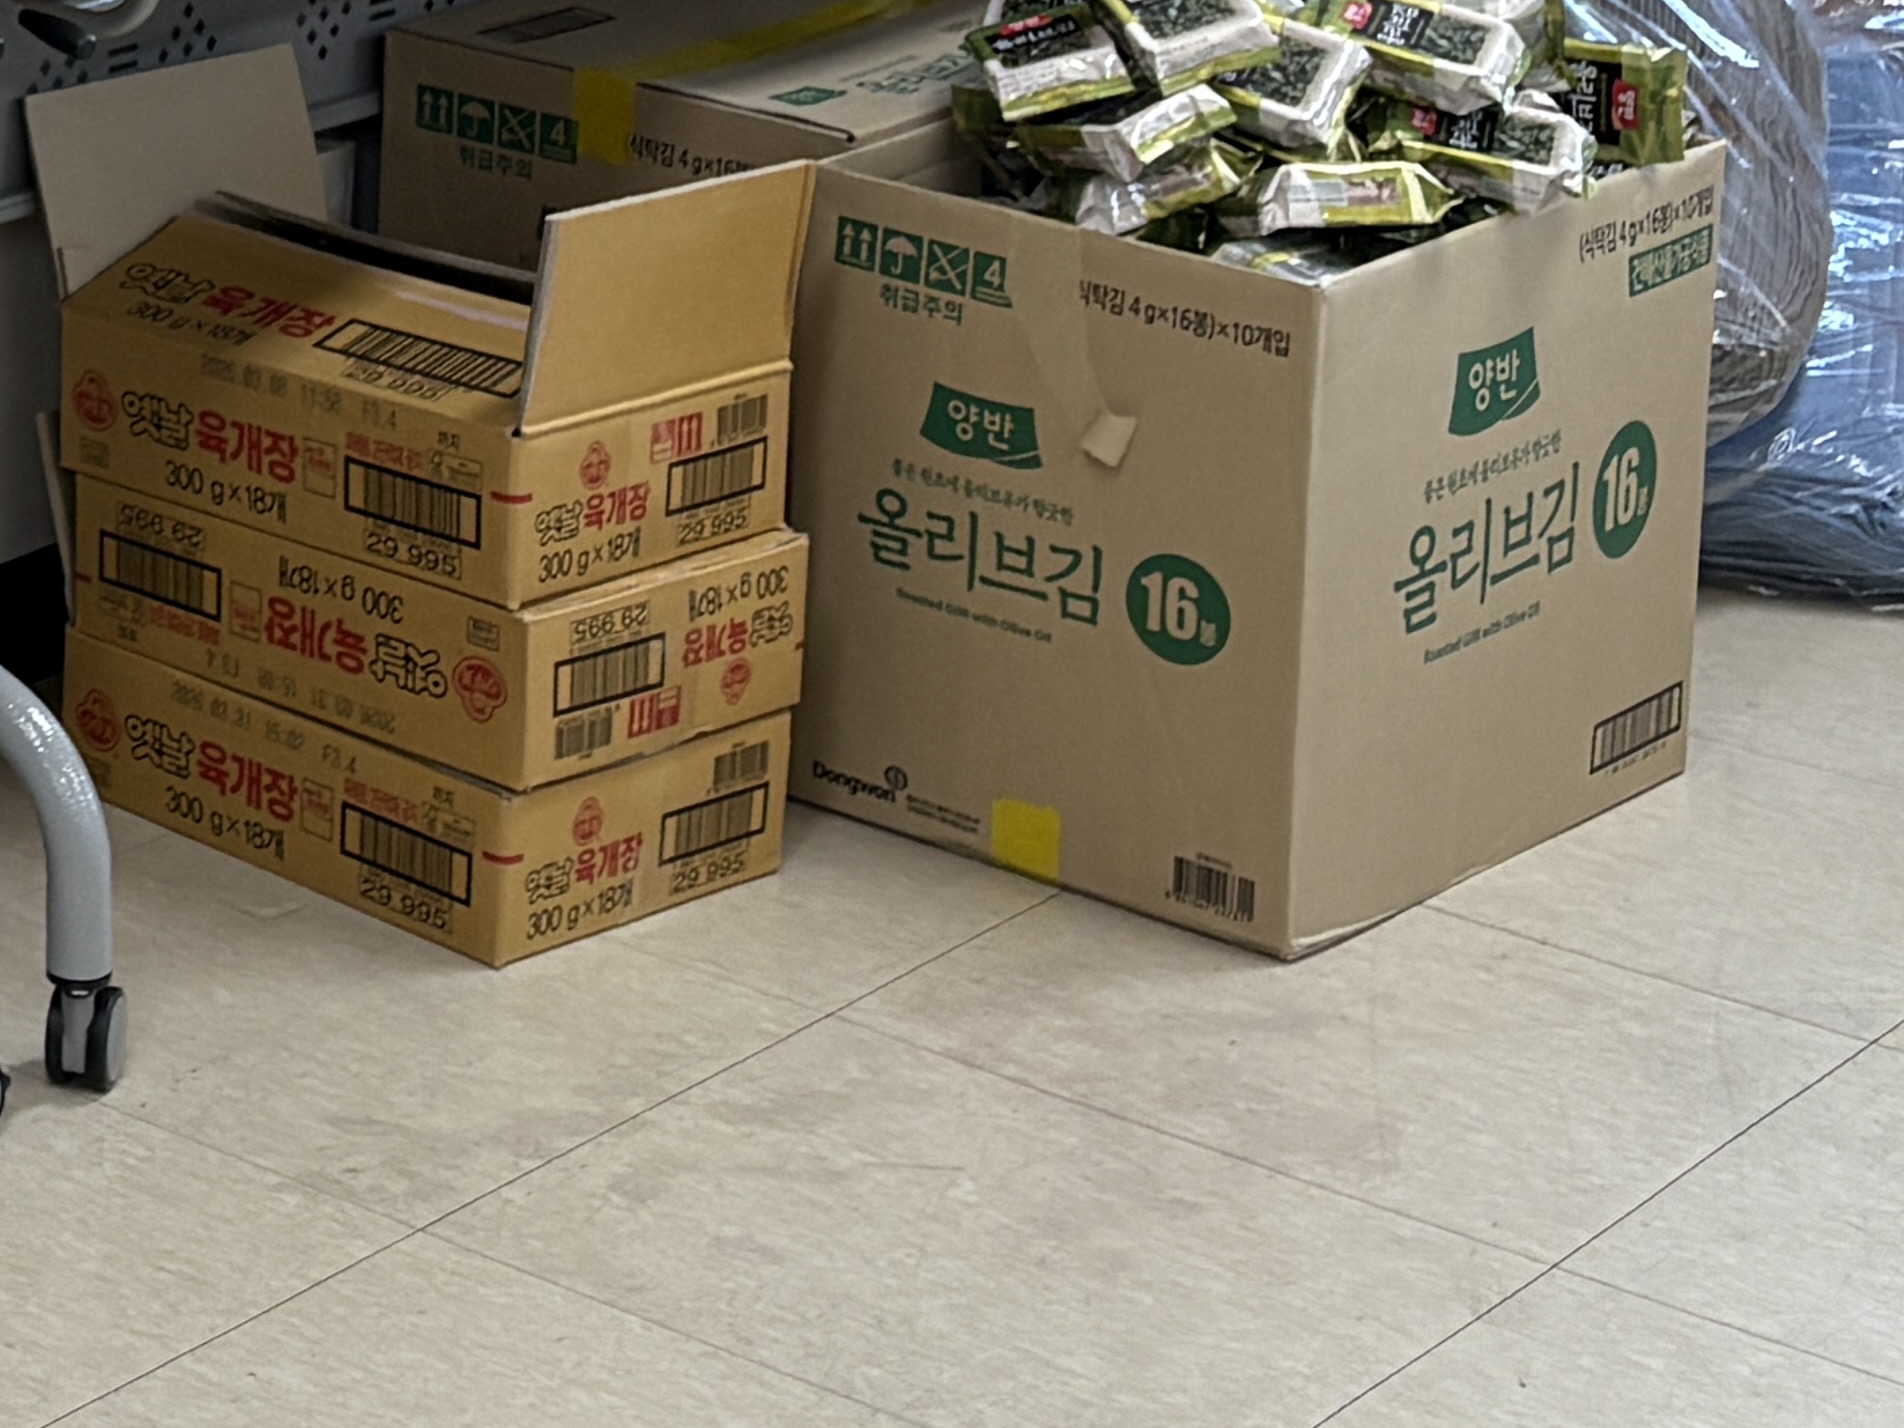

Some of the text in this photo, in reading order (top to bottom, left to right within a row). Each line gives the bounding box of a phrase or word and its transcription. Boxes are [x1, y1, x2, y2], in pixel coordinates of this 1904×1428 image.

[202, 284, 337, 342] 육개장
[879, 282, 963, 327] 취급주의
[1468, 349, 1521, 411] 양반
[121, 390, 195, 452] 옛날
[195, 408, 301, 485] 육개장
[947, 398, 1016, 452] 양반
[165, 459, 204, 496] 300
[534, 480, 652, 548] 옛날 육개장
[678, 510, 748, 545] 29 995
[365, 531, 459, 576] 29 995
[539, 548, 573, 583] 300
[857, 486, 1103, 627] 올리브김
[1393, 460, 1581, 635] 올리브김
[264, 594, 367, 676] 육개장
[681, 615, 750, 670] 육개장
[368, 631, 450, 699] 옛날
[124, 713, 196, 781] 옛날
[196, 738, 300, 823] 육개장
[812, 759, 897, 804] Dongwon
[164, 783, 204, 825] 300
[524, 831, 644, 906] 옛날 육개장
[526, 904, 564, 941] 300
